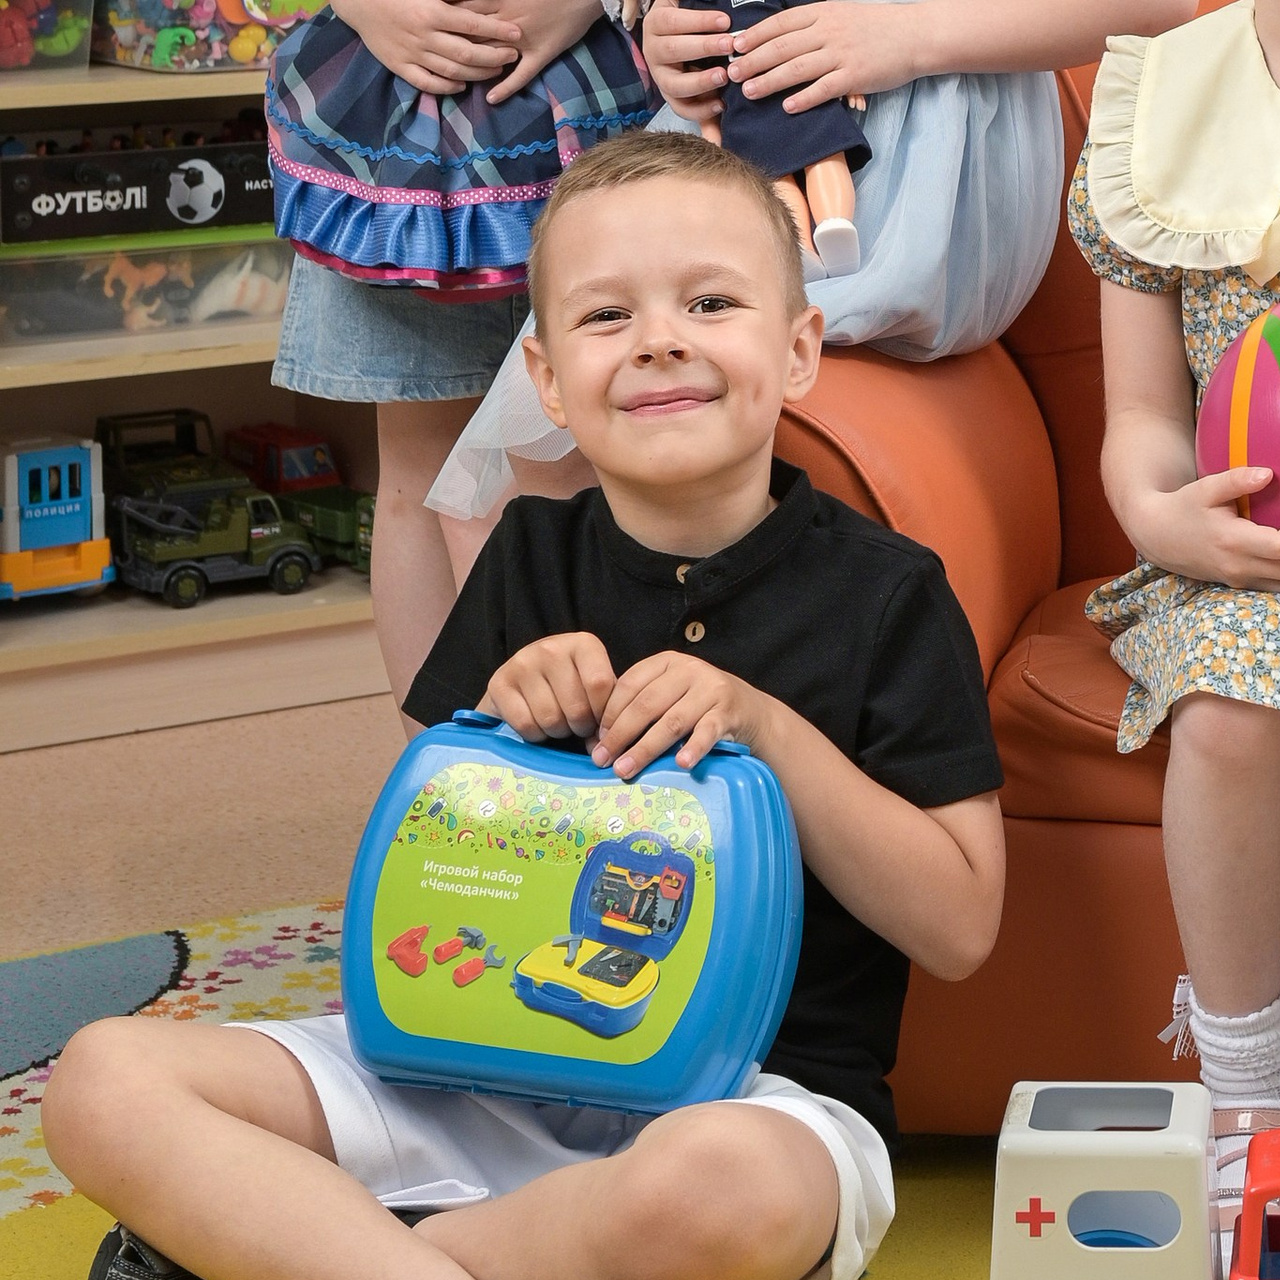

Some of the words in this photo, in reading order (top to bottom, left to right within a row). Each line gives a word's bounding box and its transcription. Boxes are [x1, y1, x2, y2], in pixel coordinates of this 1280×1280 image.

[25, 503, 80, 519] ПОЛИЦИЯ
[423, 860, 479, 879] Игровой
[482, 869, 524, 887] набор
[420, 877, 520, 901] «Чемоданчик»
